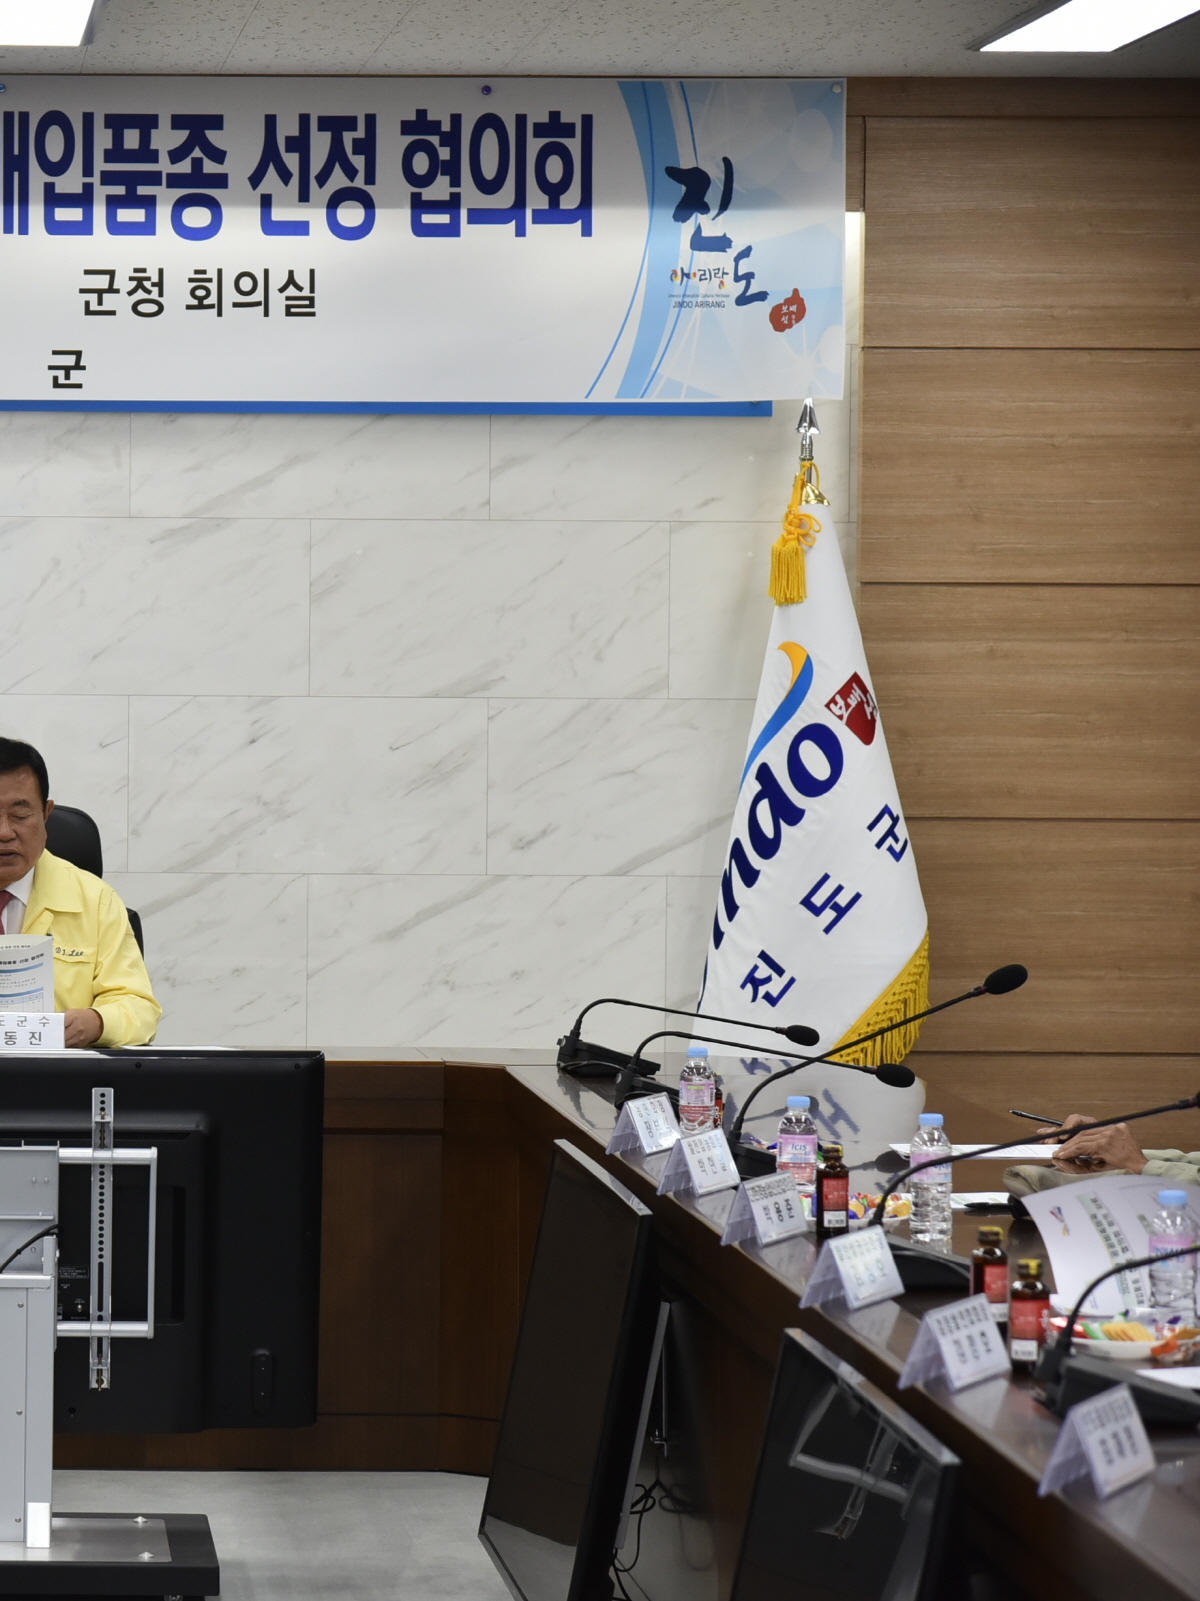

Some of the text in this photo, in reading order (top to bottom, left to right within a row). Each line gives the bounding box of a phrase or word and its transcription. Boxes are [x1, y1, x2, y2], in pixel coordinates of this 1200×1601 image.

[247, 110, 377, 241] 선정
[399, 109, 594, 240] 협의회
[78, 267, 165, 318] 군청
[185, 268, 317, 318] 회의실
[672, 301, 726, 309] JINDO ARIRANG
